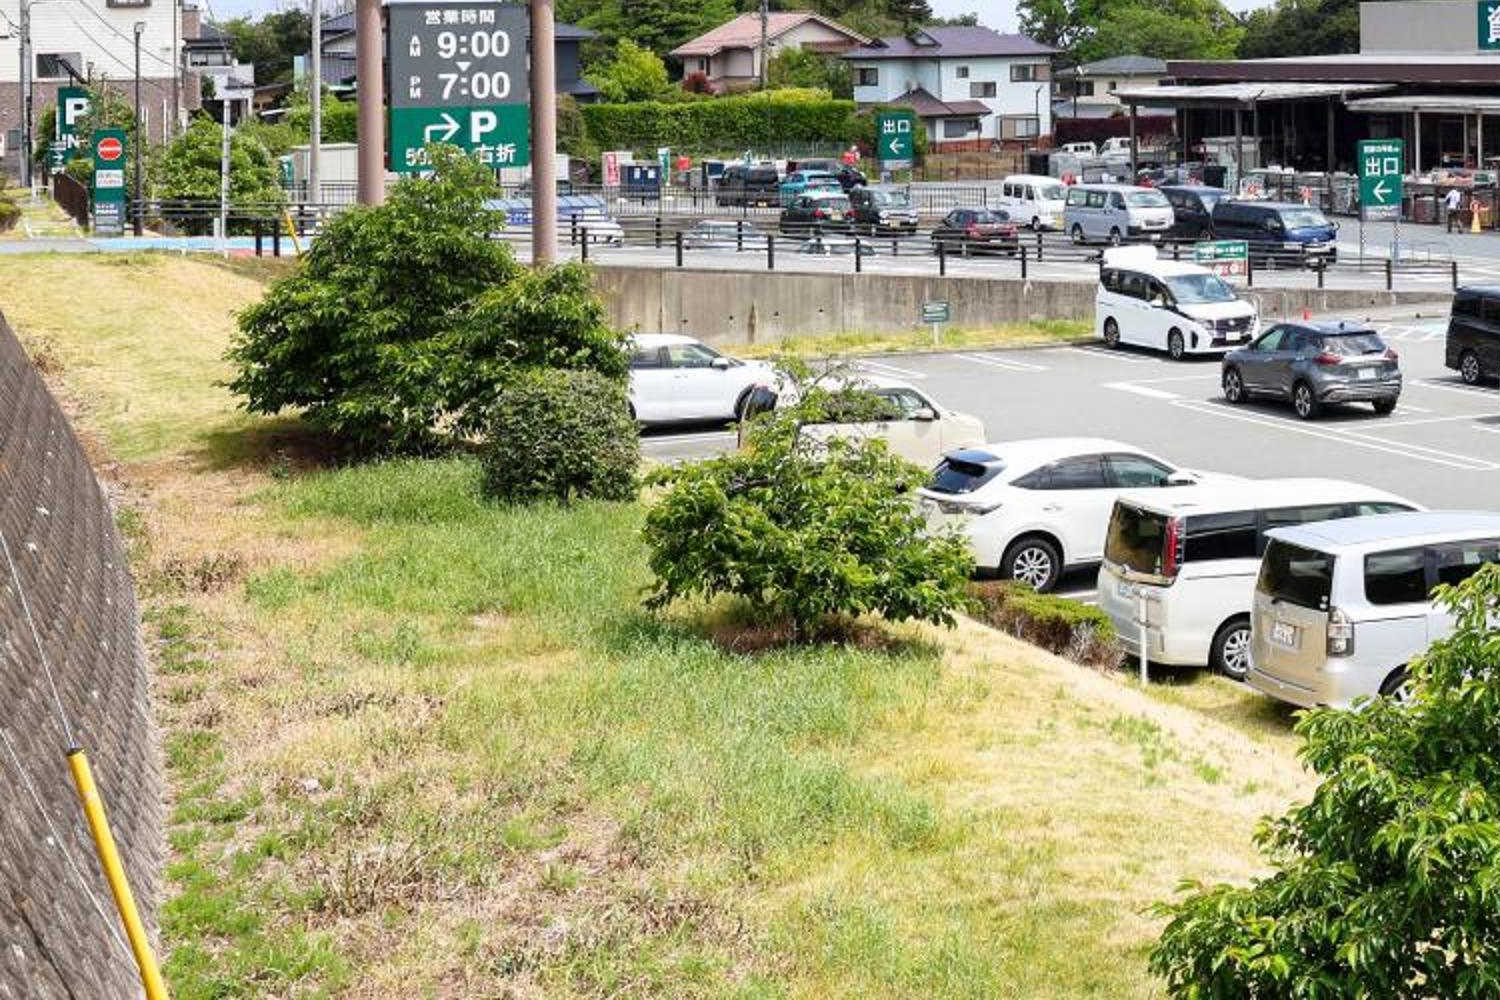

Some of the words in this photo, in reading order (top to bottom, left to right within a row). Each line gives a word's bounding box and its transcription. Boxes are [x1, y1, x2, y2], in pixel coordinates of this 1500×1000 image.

[425, 9, 495, 25] 営業時間
[437, 30, 510, 58] 9:00
[437, 72, 511, 100] 7:00
[470, 110, 497, 142] P
[883, 119, 910, 134] 出口
[1365, 156, 1399, 177] 出口
